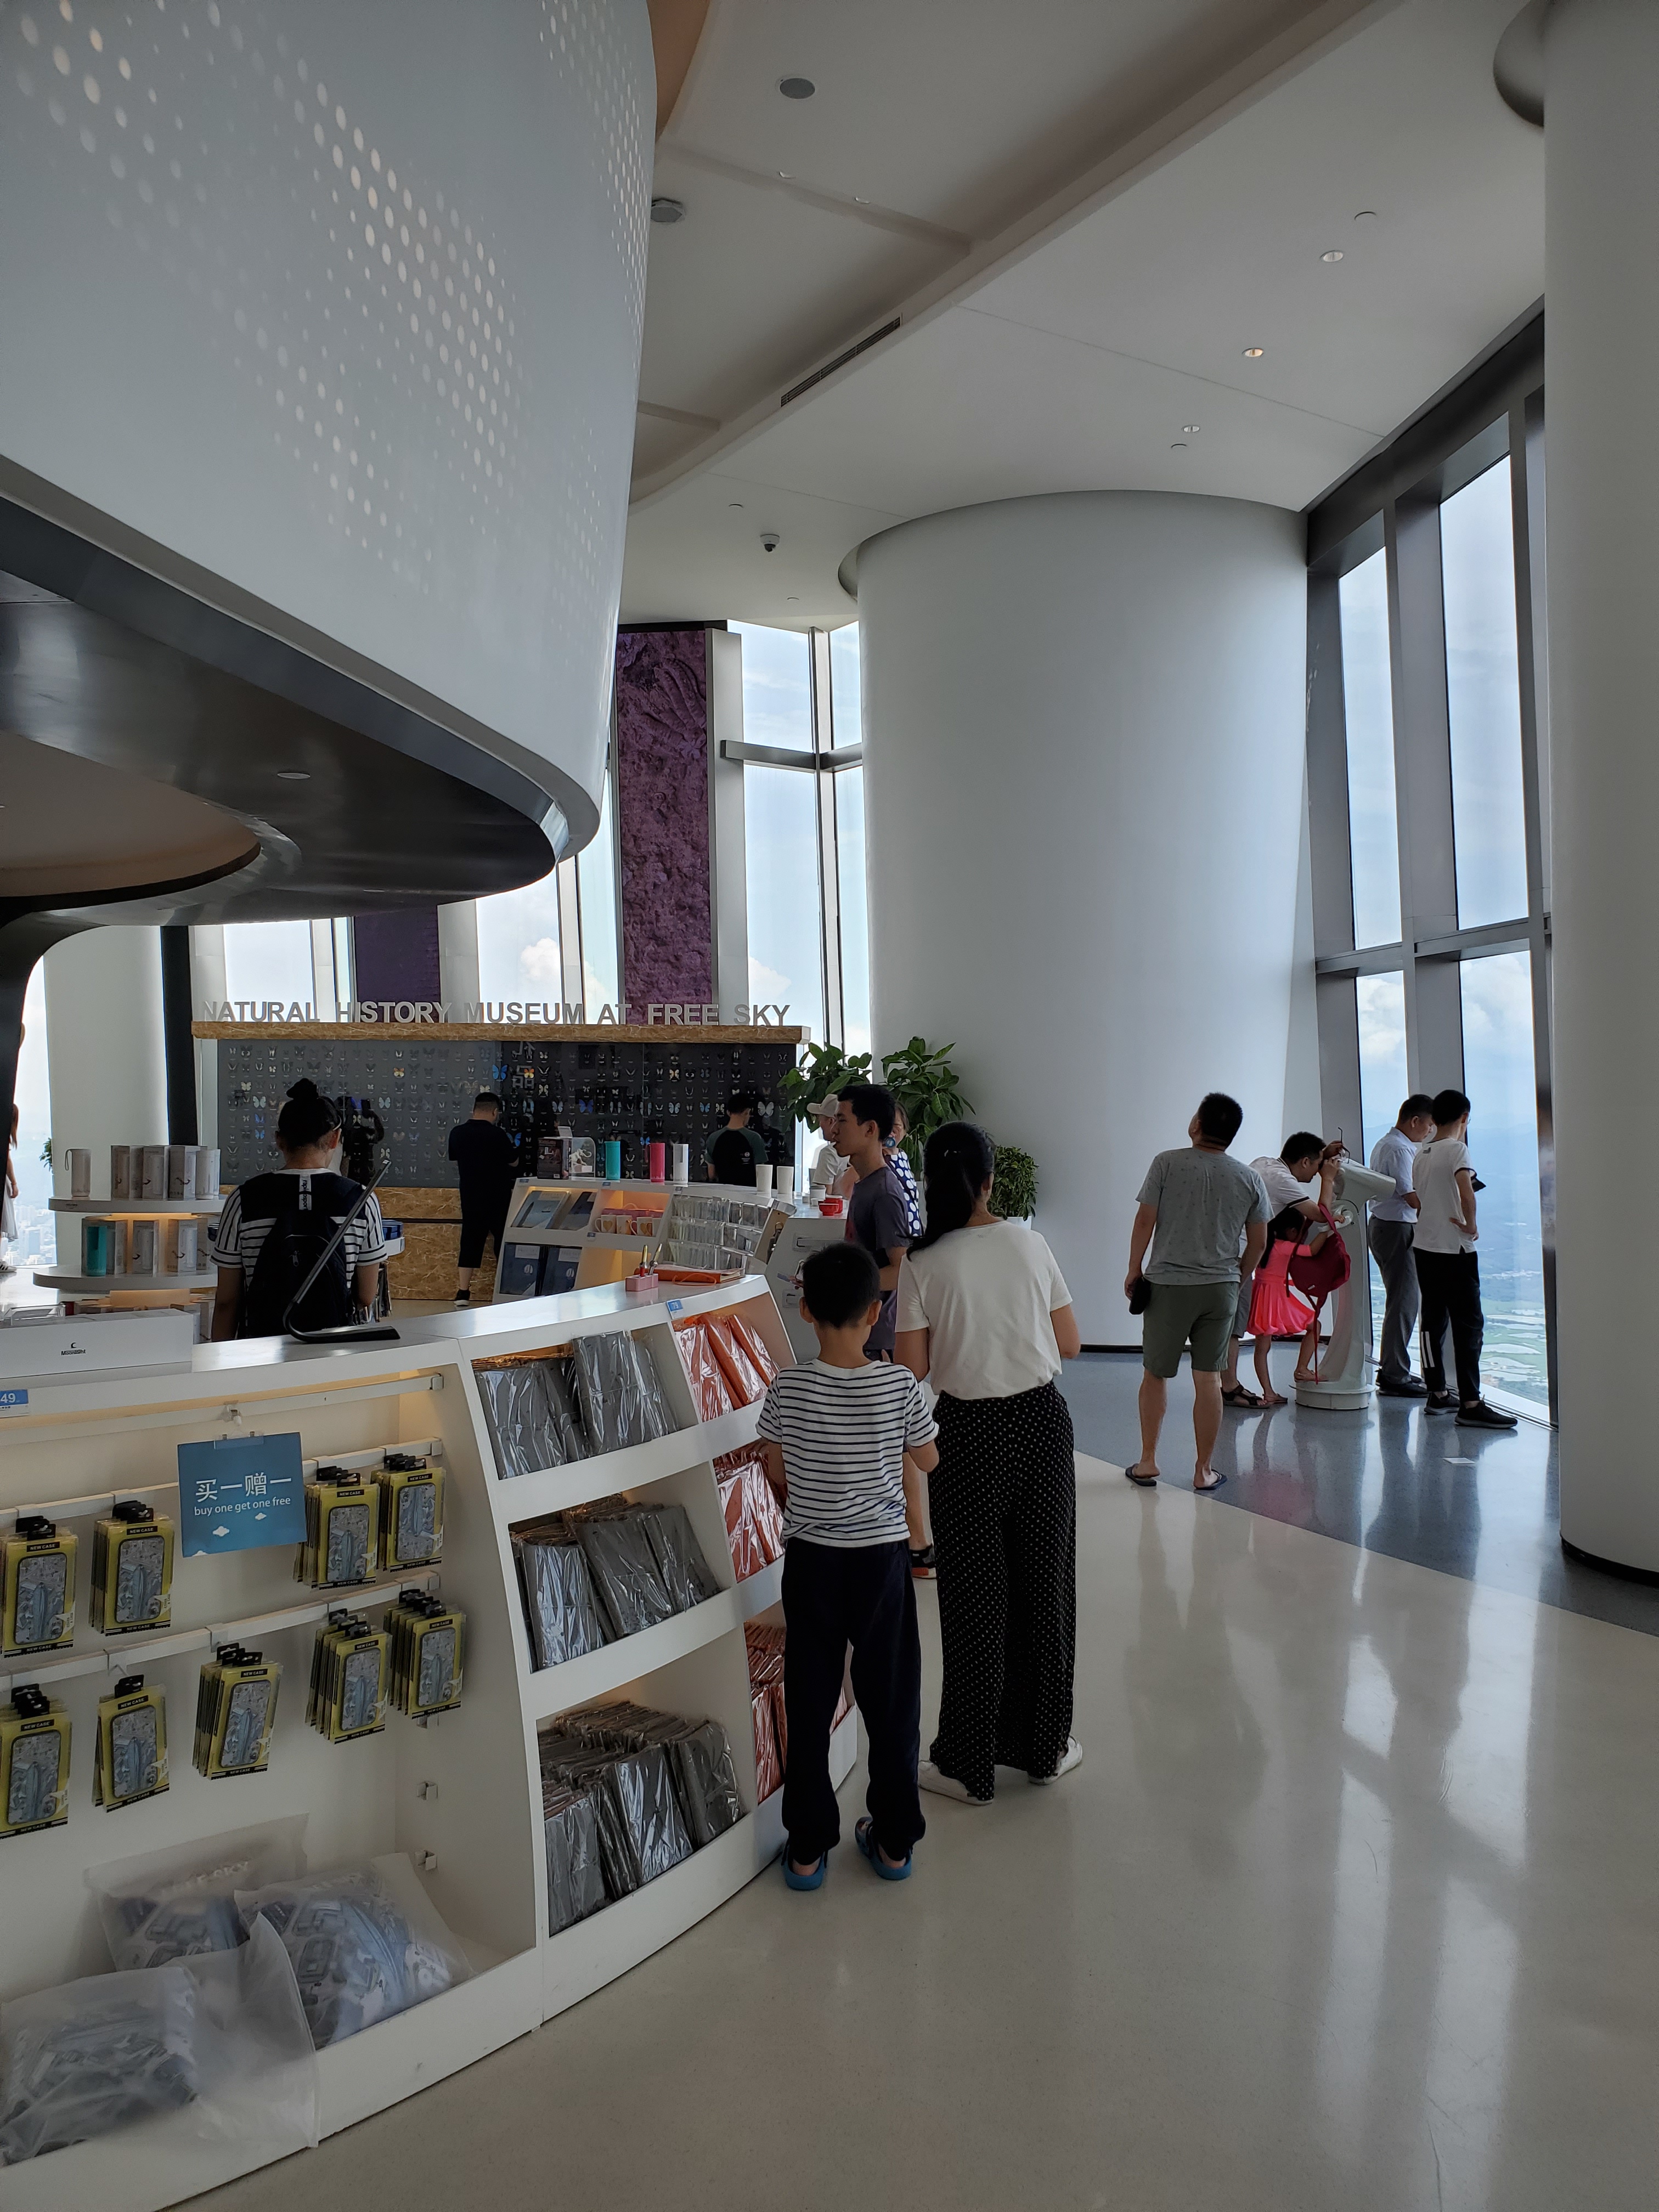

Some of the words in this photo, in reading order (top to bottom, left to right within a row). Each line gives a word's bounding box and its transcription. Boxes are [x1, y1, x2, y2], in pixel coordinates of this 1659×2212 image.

[204, 1001, 320, 1023] NATURAL
[336, 1001, 453, 1024] HISTORY
[464, 1002, 584, 1025] MUSEUM
[597, 1003, 632, 1025] AT
[647, 1003, 720, 1026] FREE
[733, 1005, 791, 1026] SKY
[0, 1393, 16, 1403] 49
[195, 1472, 292, 1503] 买一赠一
[194, 1506, 213, 1517] buy
[215, 1505, 233, 1514] one
[235, 1502, 250, 1513] get
[253, 1500, 270, 1509] one
[272, 1497, 291, 1506] free
